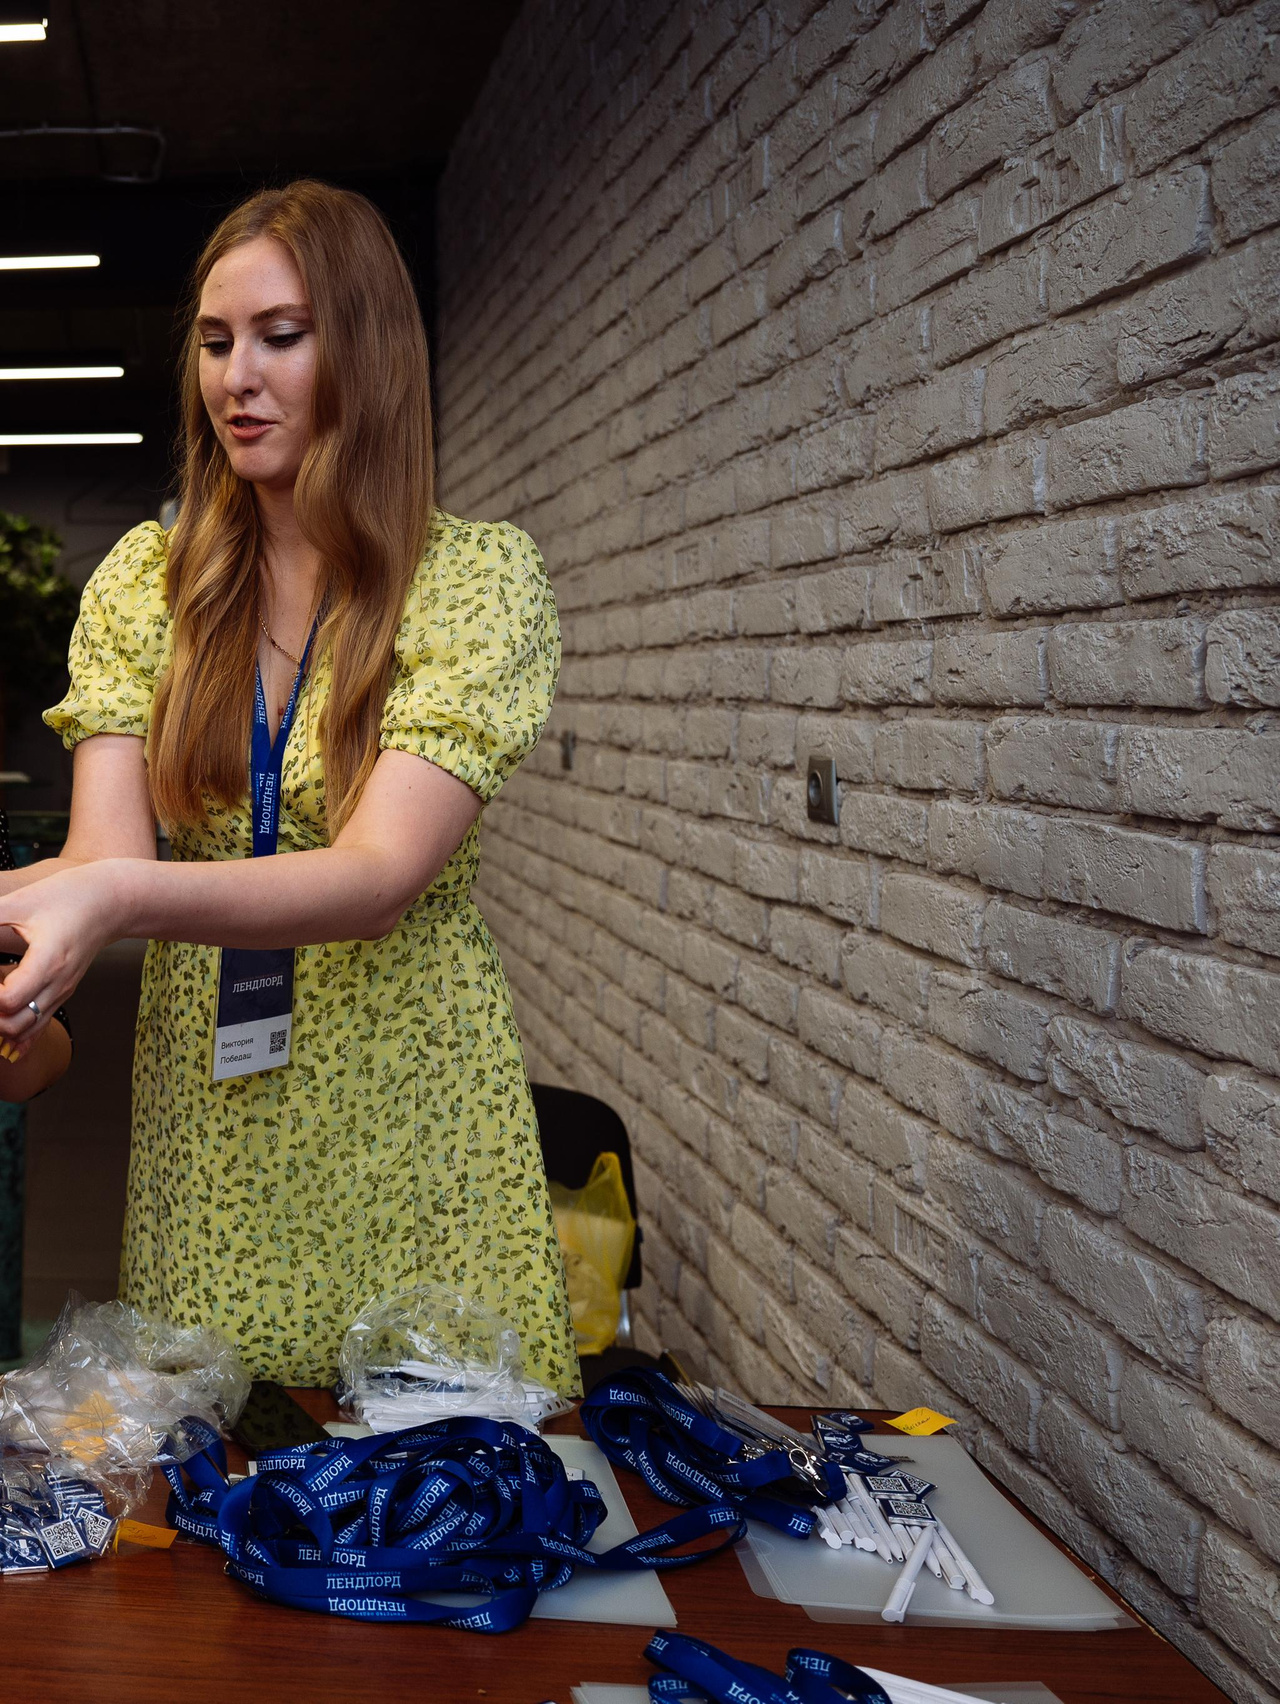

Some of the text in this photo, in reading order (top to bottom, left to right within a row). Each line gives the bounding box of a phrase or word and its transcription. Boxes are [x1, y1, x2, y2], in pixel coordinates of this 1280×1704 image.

[259, 773, 274, 834] ЛЕНДЛОРД
[232, 975, 284, 993] ЛЕНДЛОРД
[221, 1037, 253, 1050] Виктория
[220, 1051, 252, 1064] Победаш
[638, 1450, 690, 1506] ЛЕНДЛОРД
[666, 1451, 724, 1499] ЛЕНДЛОРД
[372, 1487, 389, 1547] НДЛОРД
[538, 1535, 596, 1565] ЛЕНДЛОРД
[625, 1533, 676, 1555] ЛЕНДЛОРД
[326, 1576, 402, 1591] ЛЕНДЛОРД
[328, 1597, 407, 1612] ЛЕНДЛОРД
